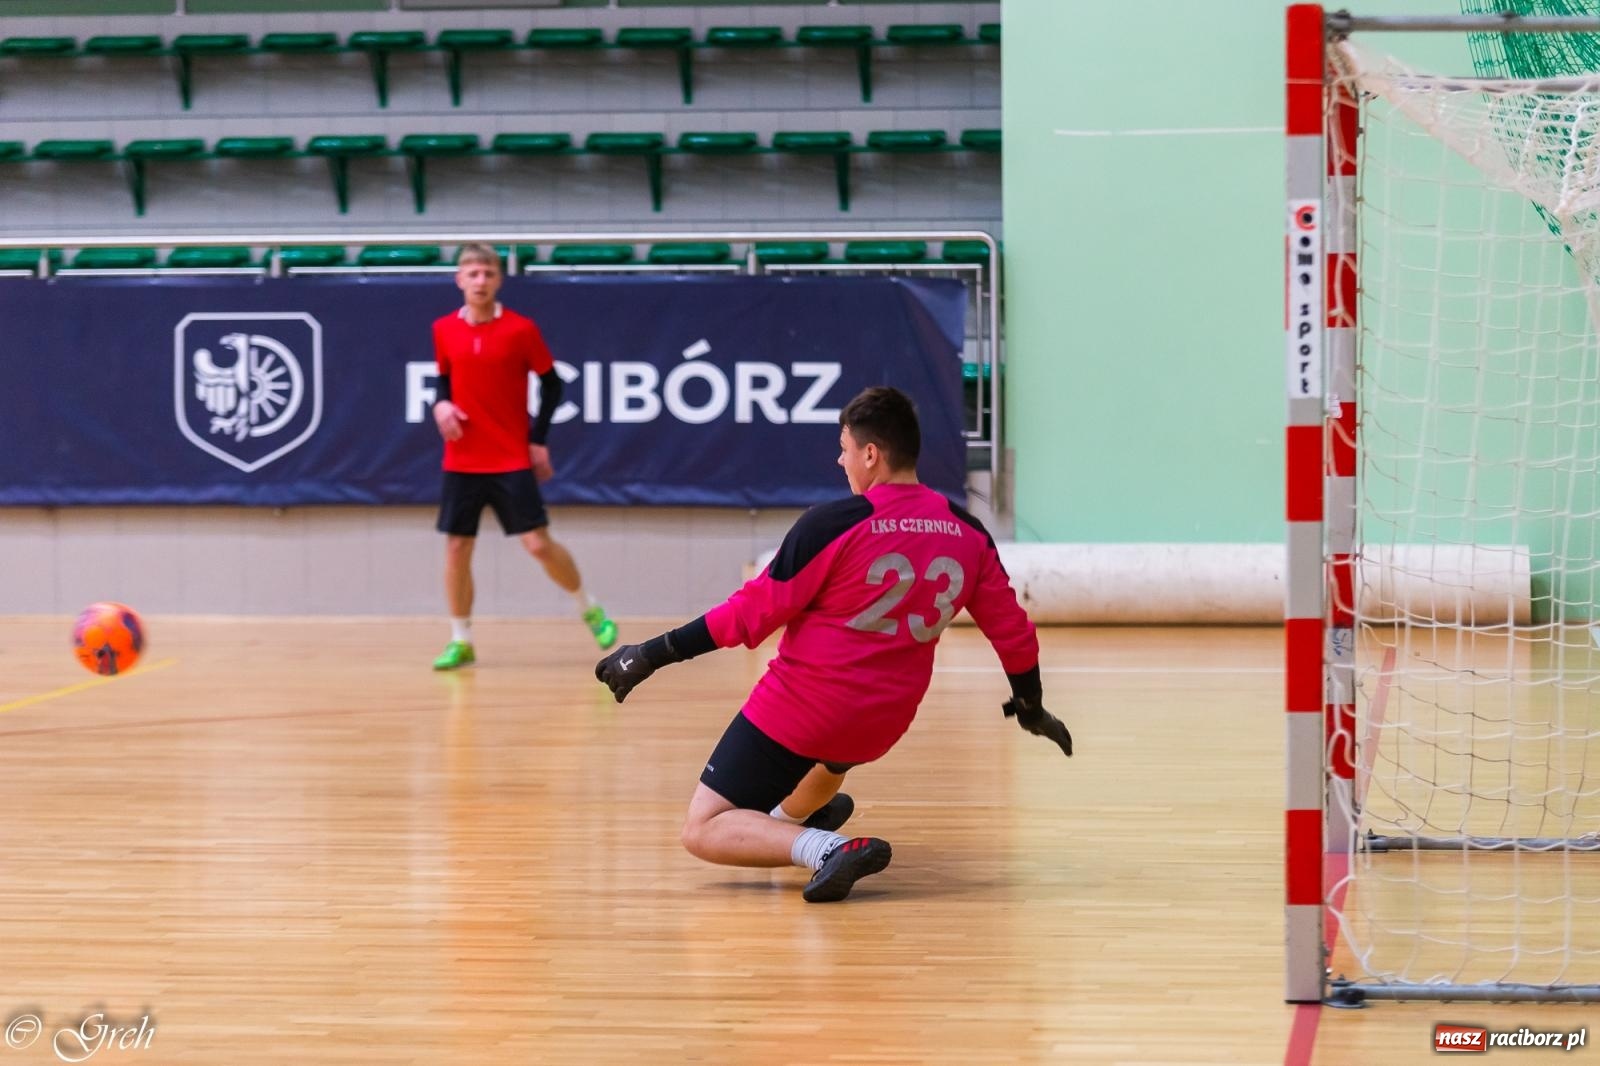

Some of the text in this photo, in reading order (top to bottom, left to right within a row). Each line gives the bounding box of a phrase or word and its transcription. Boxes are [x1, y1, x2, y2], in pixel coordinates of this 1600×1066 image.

[405, 338, 843, 424] RCIBÓRZ
[1298, 303, 1312, 394] sport
[871, 518, 962, 536] LKS CZERNICA
[845, 552, 965, 643] 23
